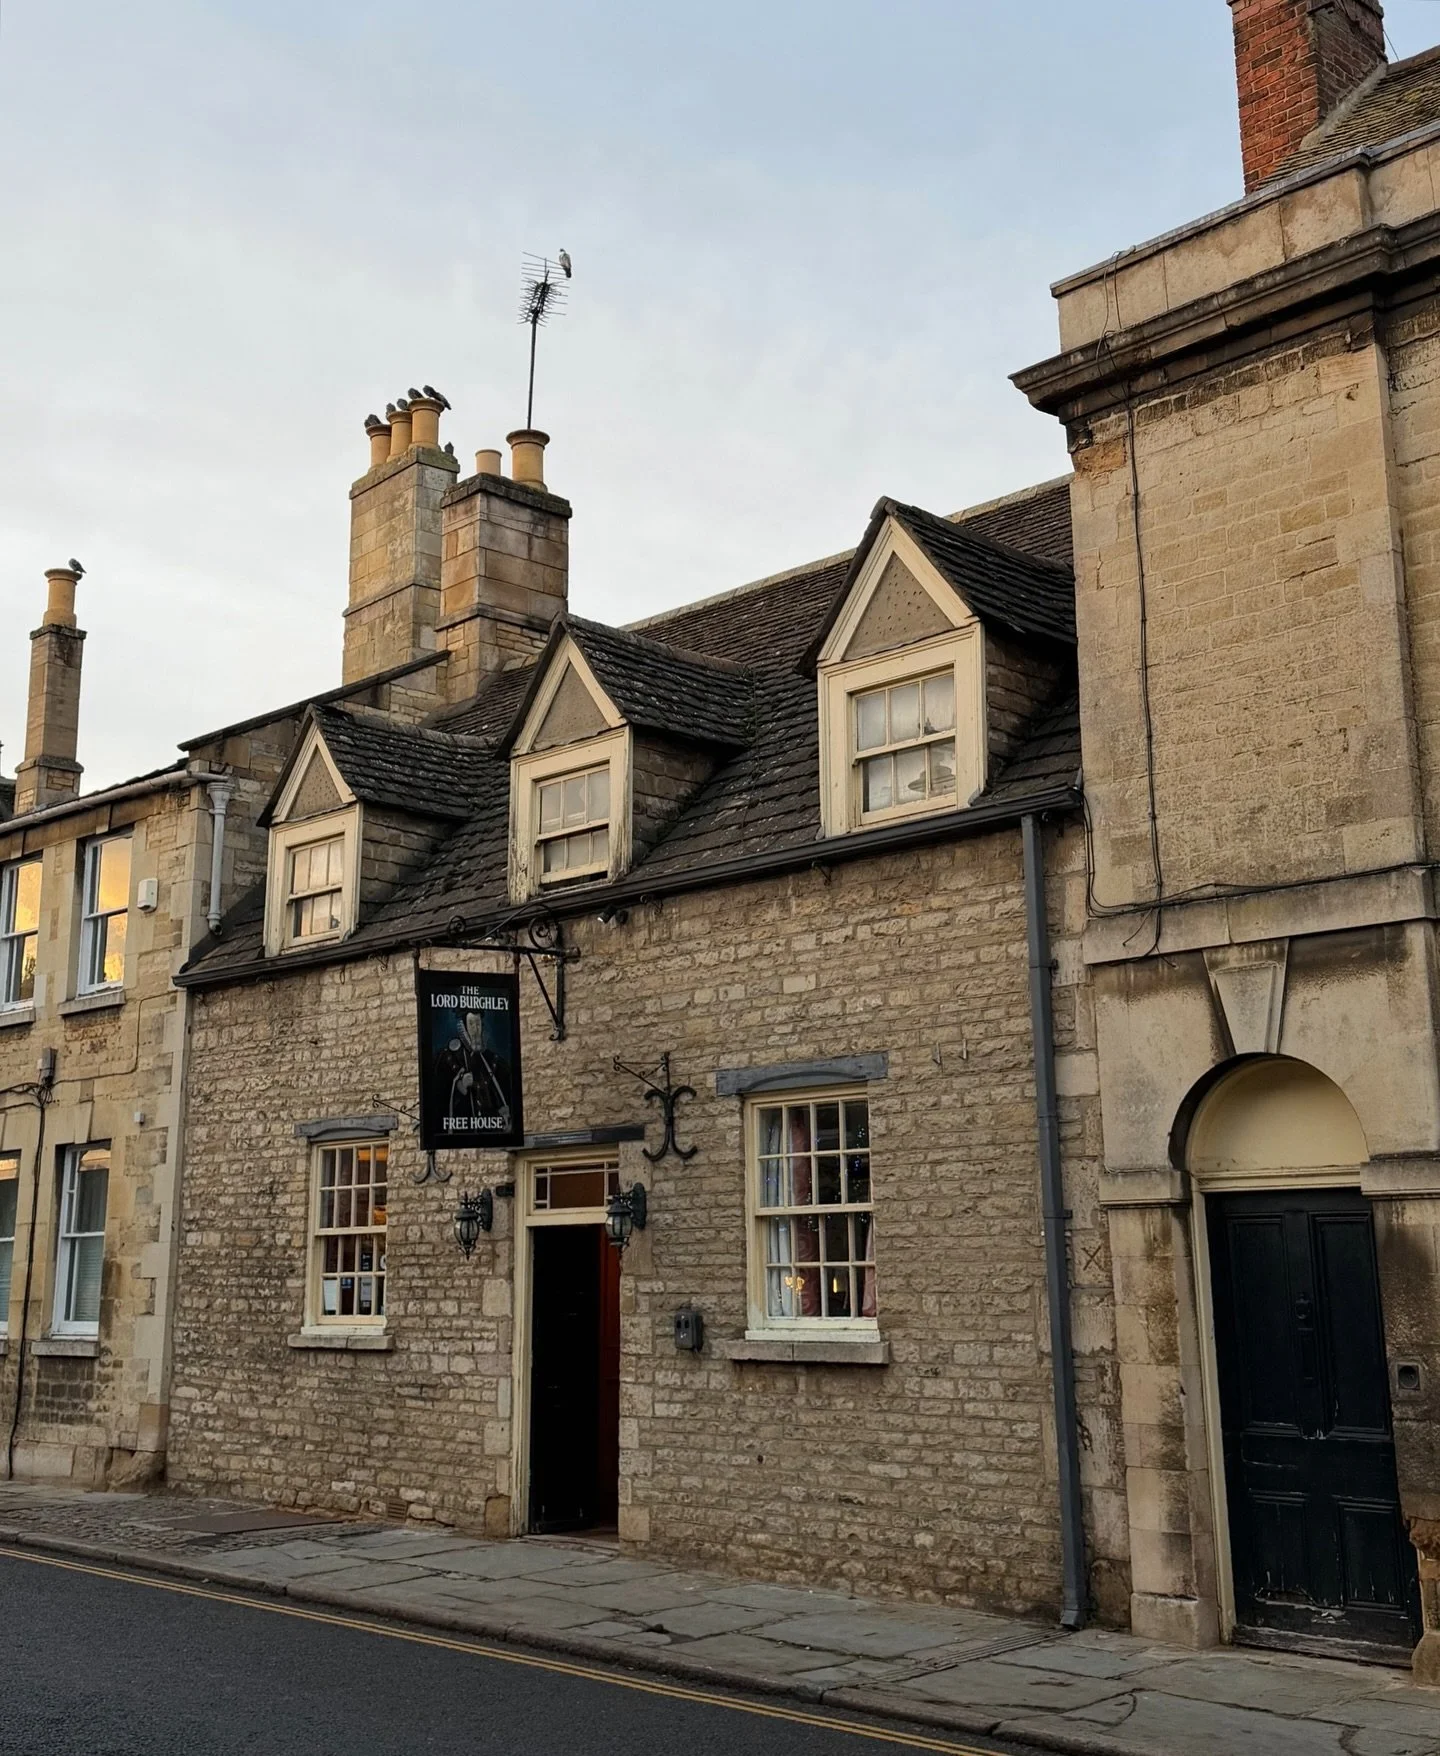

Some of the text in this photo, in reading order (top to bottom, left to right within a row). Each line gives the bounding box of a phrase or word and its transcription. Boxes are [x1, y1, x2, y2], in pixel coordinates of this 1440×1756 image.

[462, 986, 479, 995] THE
[431, 994, 509, 1011] LORD BURGHLEY
[443, 1116, 503, 1130] FREE HOUSE
